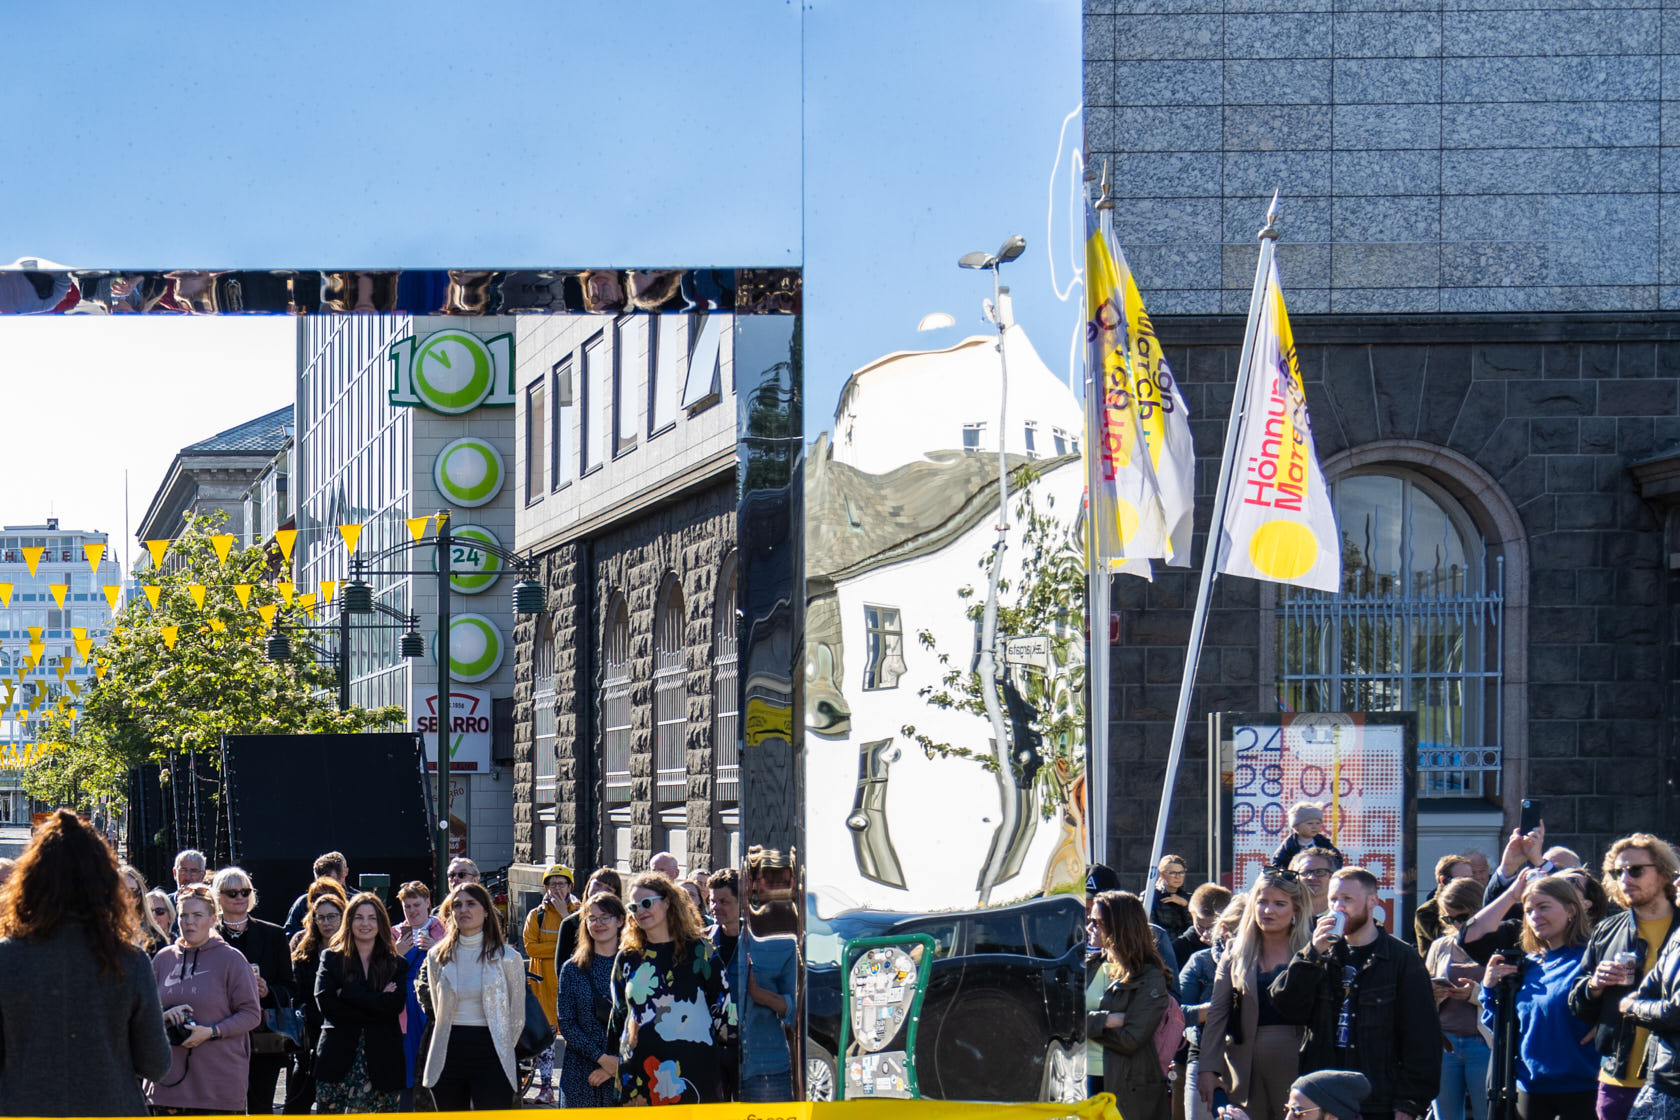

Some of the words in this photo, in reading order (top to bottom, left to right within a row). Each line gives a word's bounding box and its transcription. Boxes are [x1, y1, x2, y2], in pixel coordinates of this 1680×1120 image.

[452, 548, 480, 567] 24
[417, 716, 489, 733] SBRRO
[1233, 802, 1345, 836] 200
